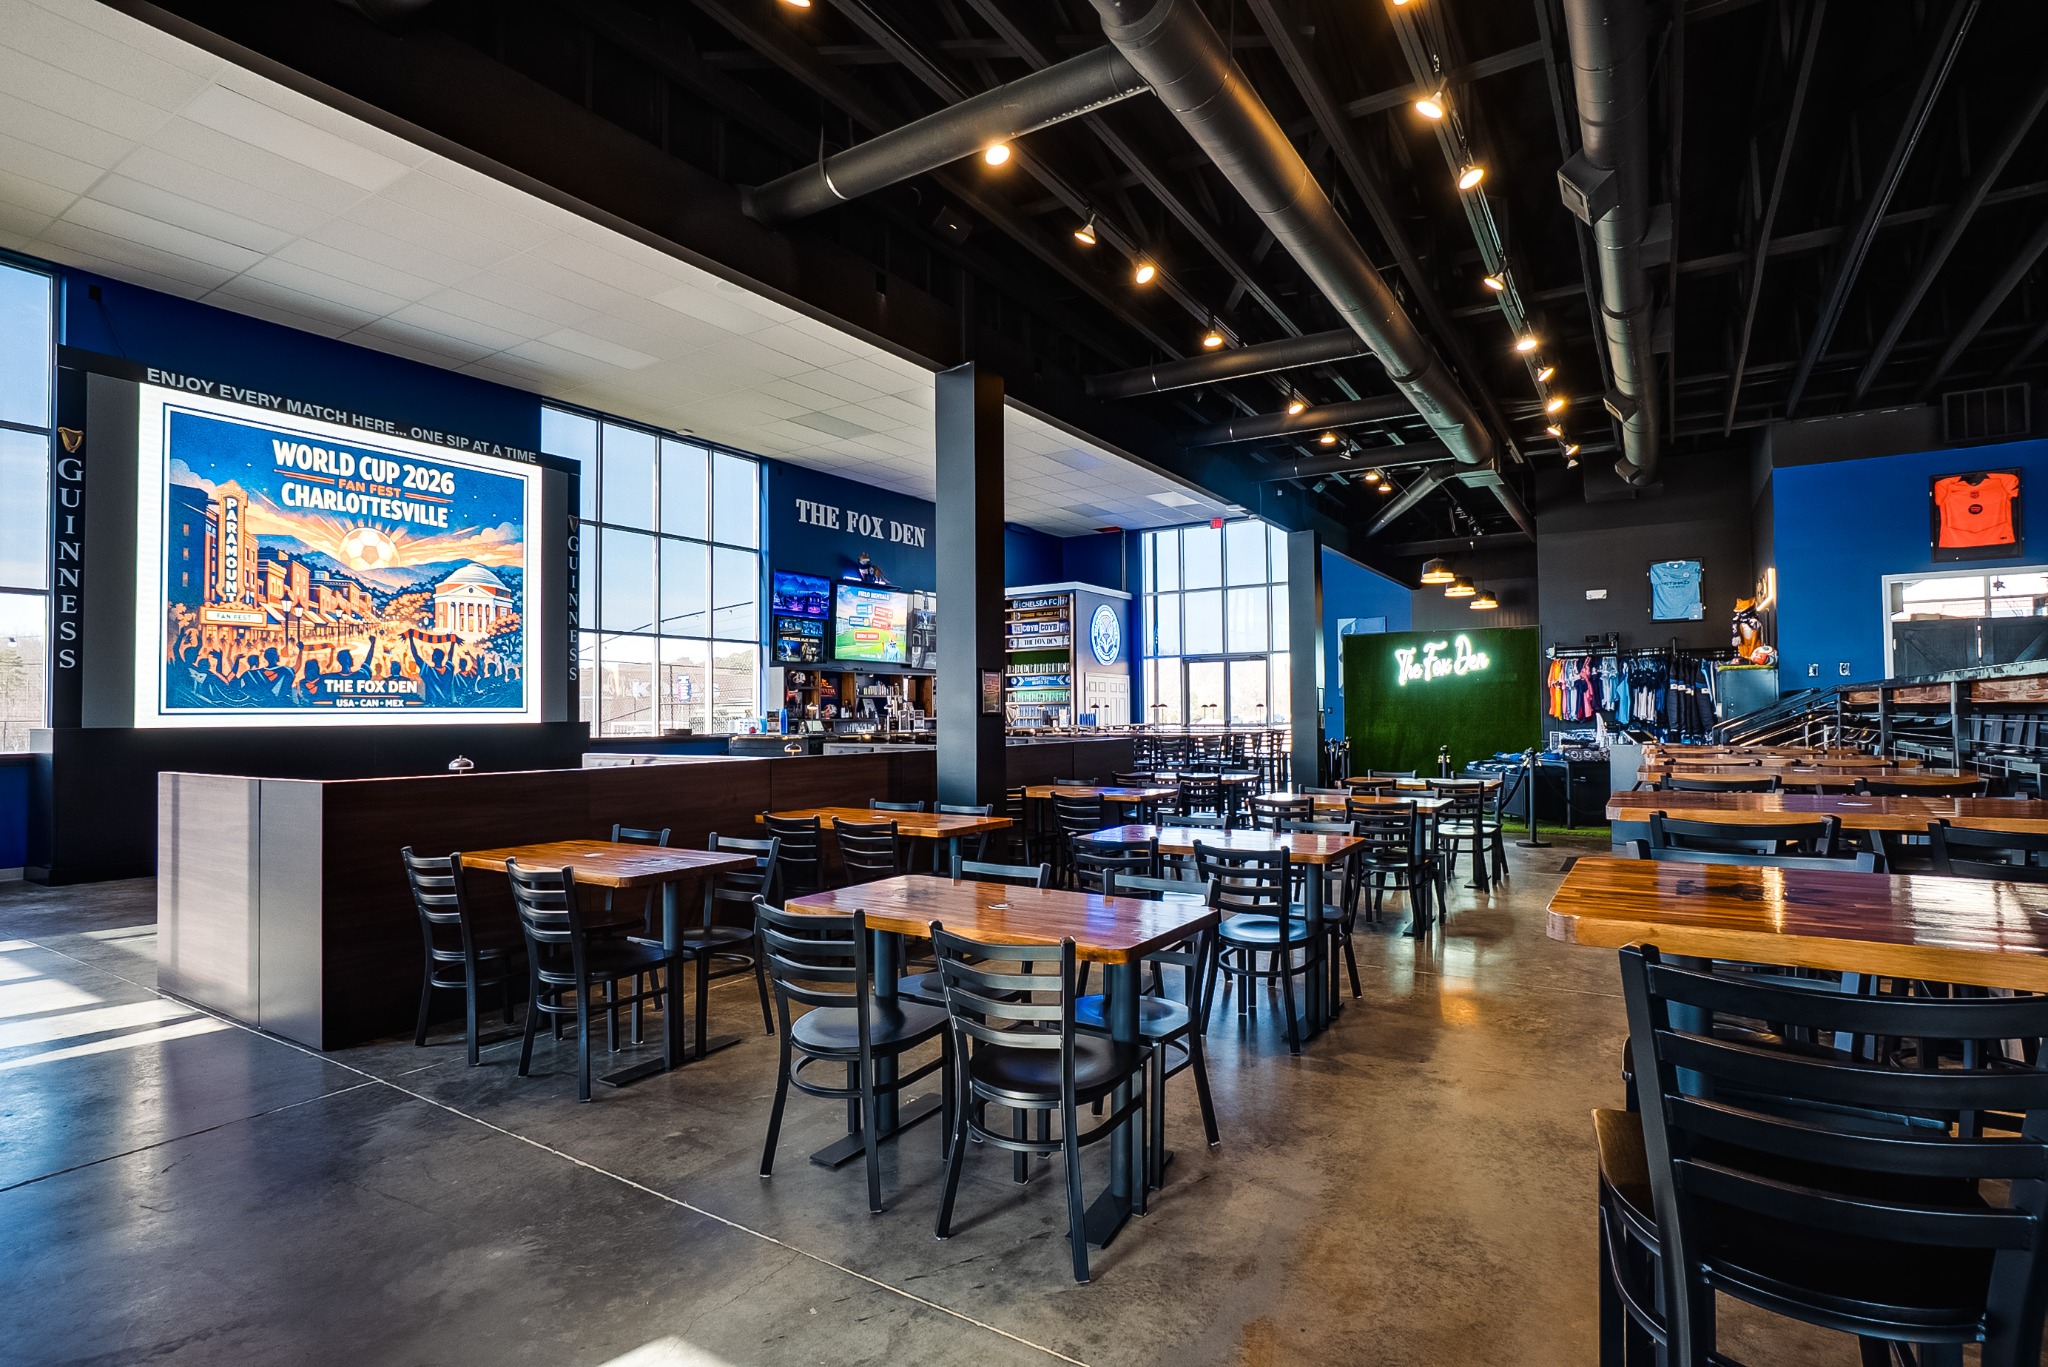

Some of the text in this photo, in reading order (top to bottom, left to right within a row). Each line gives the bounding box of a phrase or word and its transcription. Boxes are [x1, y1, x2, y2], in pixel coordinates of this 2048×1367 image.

[147, 367, 536, 463] ENJOY EVERY MATCH HERE... ONE SIP AT A TIME
[272, 439, 455, 495] WORLD CUP 2026
[338, 478, 402, 498] FAN FEST
[281, 482, 448, 528] CHARLOTTESVILLE
[796, 498, 926, 548] THE FOX DEN
[57, 457, 84, 669] GUINNESS
[226, 498, 238, 602] PARAMOUNT
[216, 612, 231, 620] FAN
[568, 536, 578, 680] GUINNESS
[1022, 598, 1058, 608] CHELSEA FC
[1394, 634, 1490, 686] The Fox Den
[324, 680, 418, 694] THE FOX DEN
[336, 699, 404, 707] USA CAN MEX
